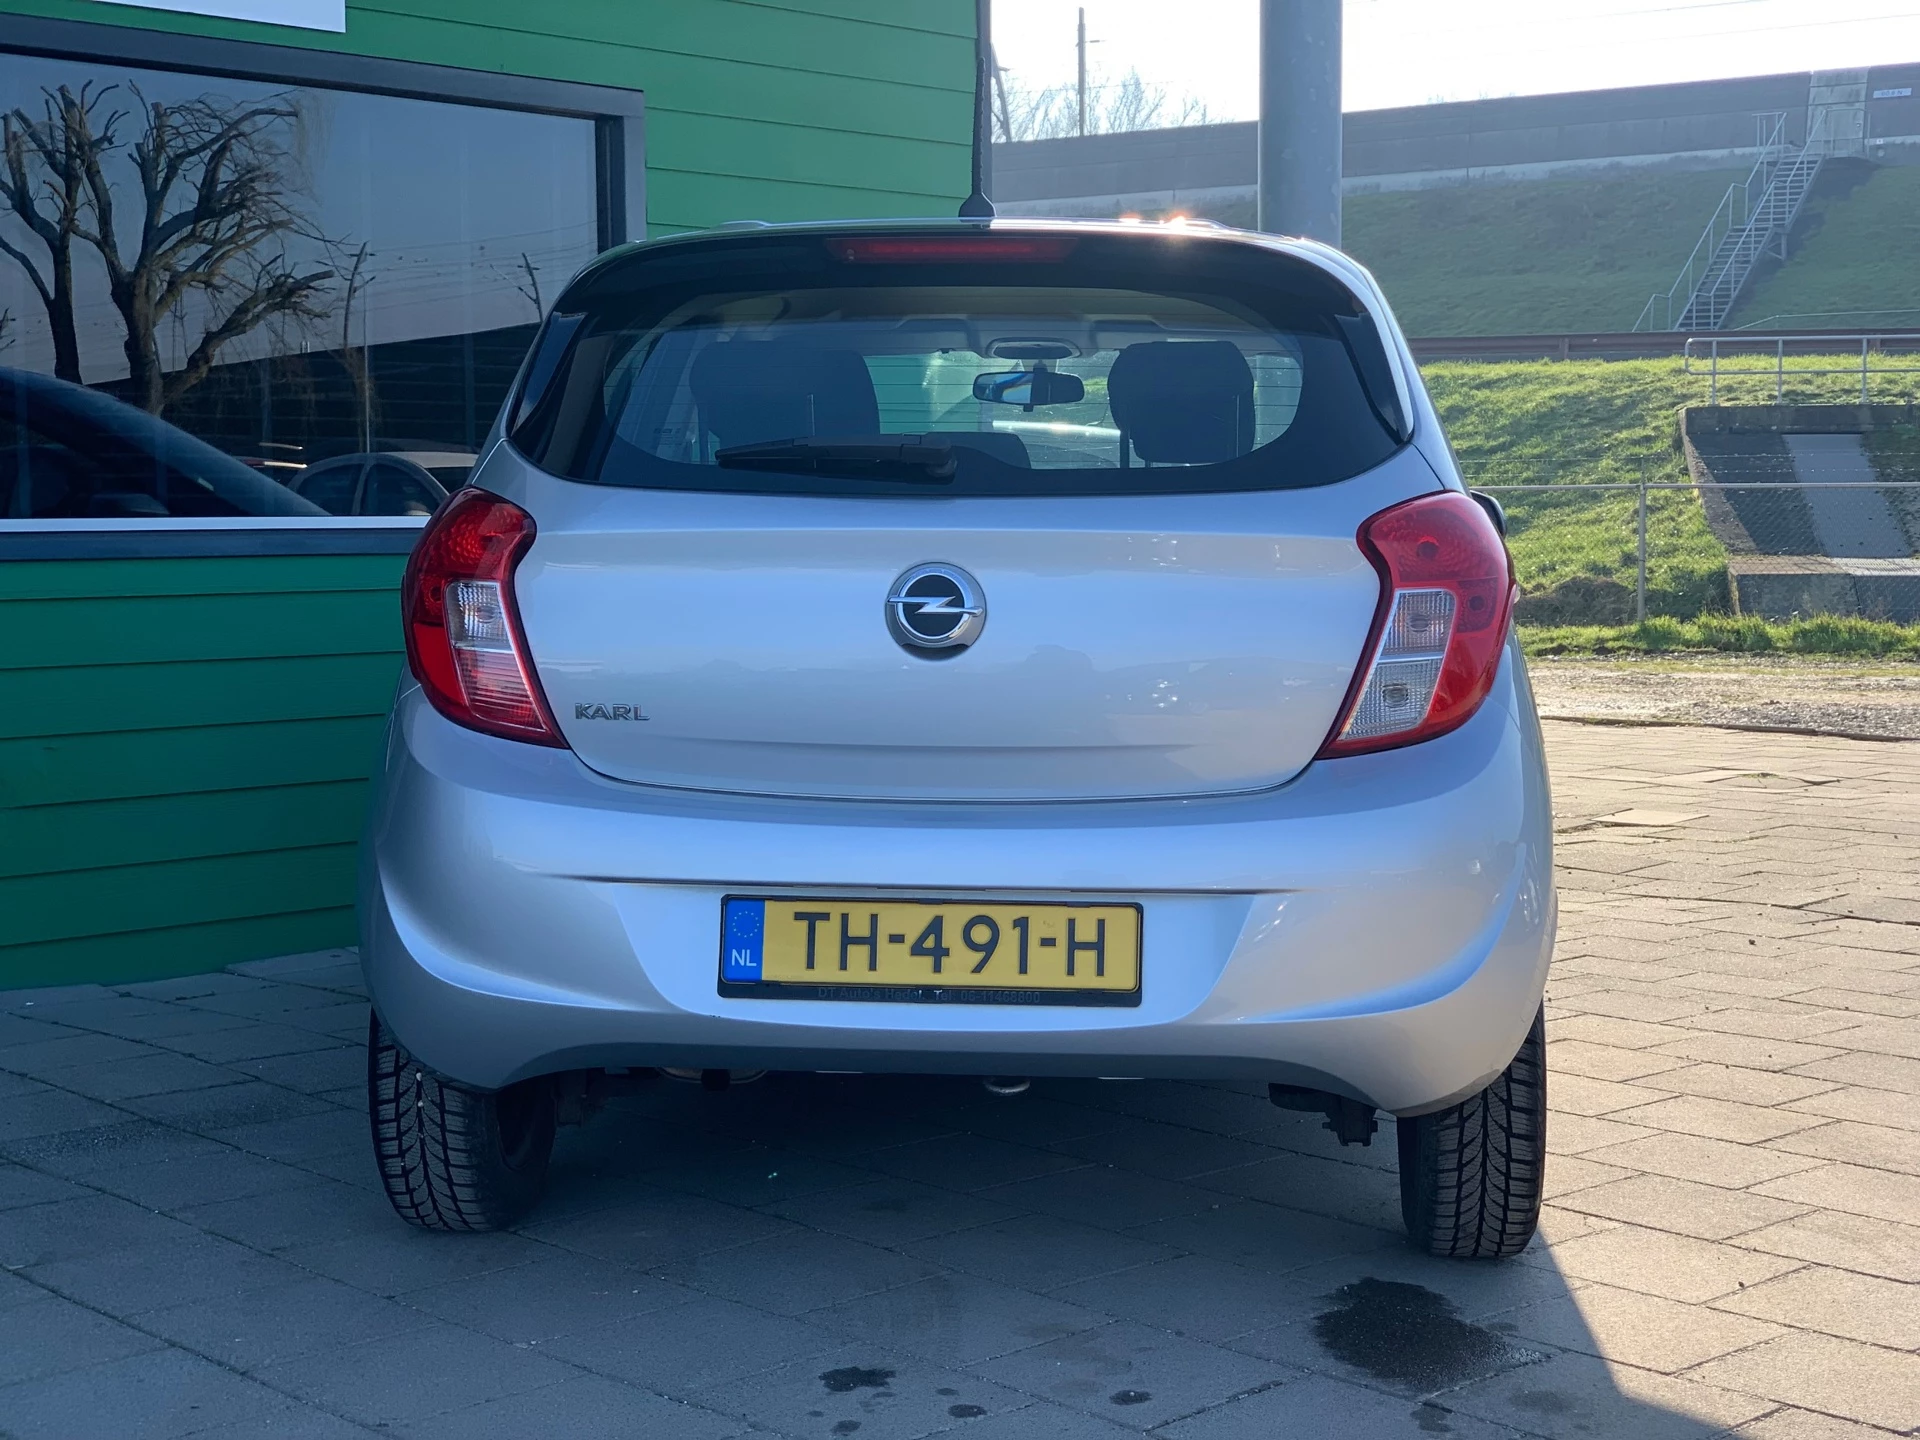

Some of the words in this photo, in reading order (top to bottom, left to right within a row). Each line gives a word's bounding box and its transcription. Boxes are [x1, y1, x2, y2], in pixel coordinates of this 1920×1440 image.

[574, 702, 651, 721] KARL
[793, 911, 1106, 977] TH-491-H
[731, 949, 757, 967] NL
[840, 987, 880, 999] Auto's
